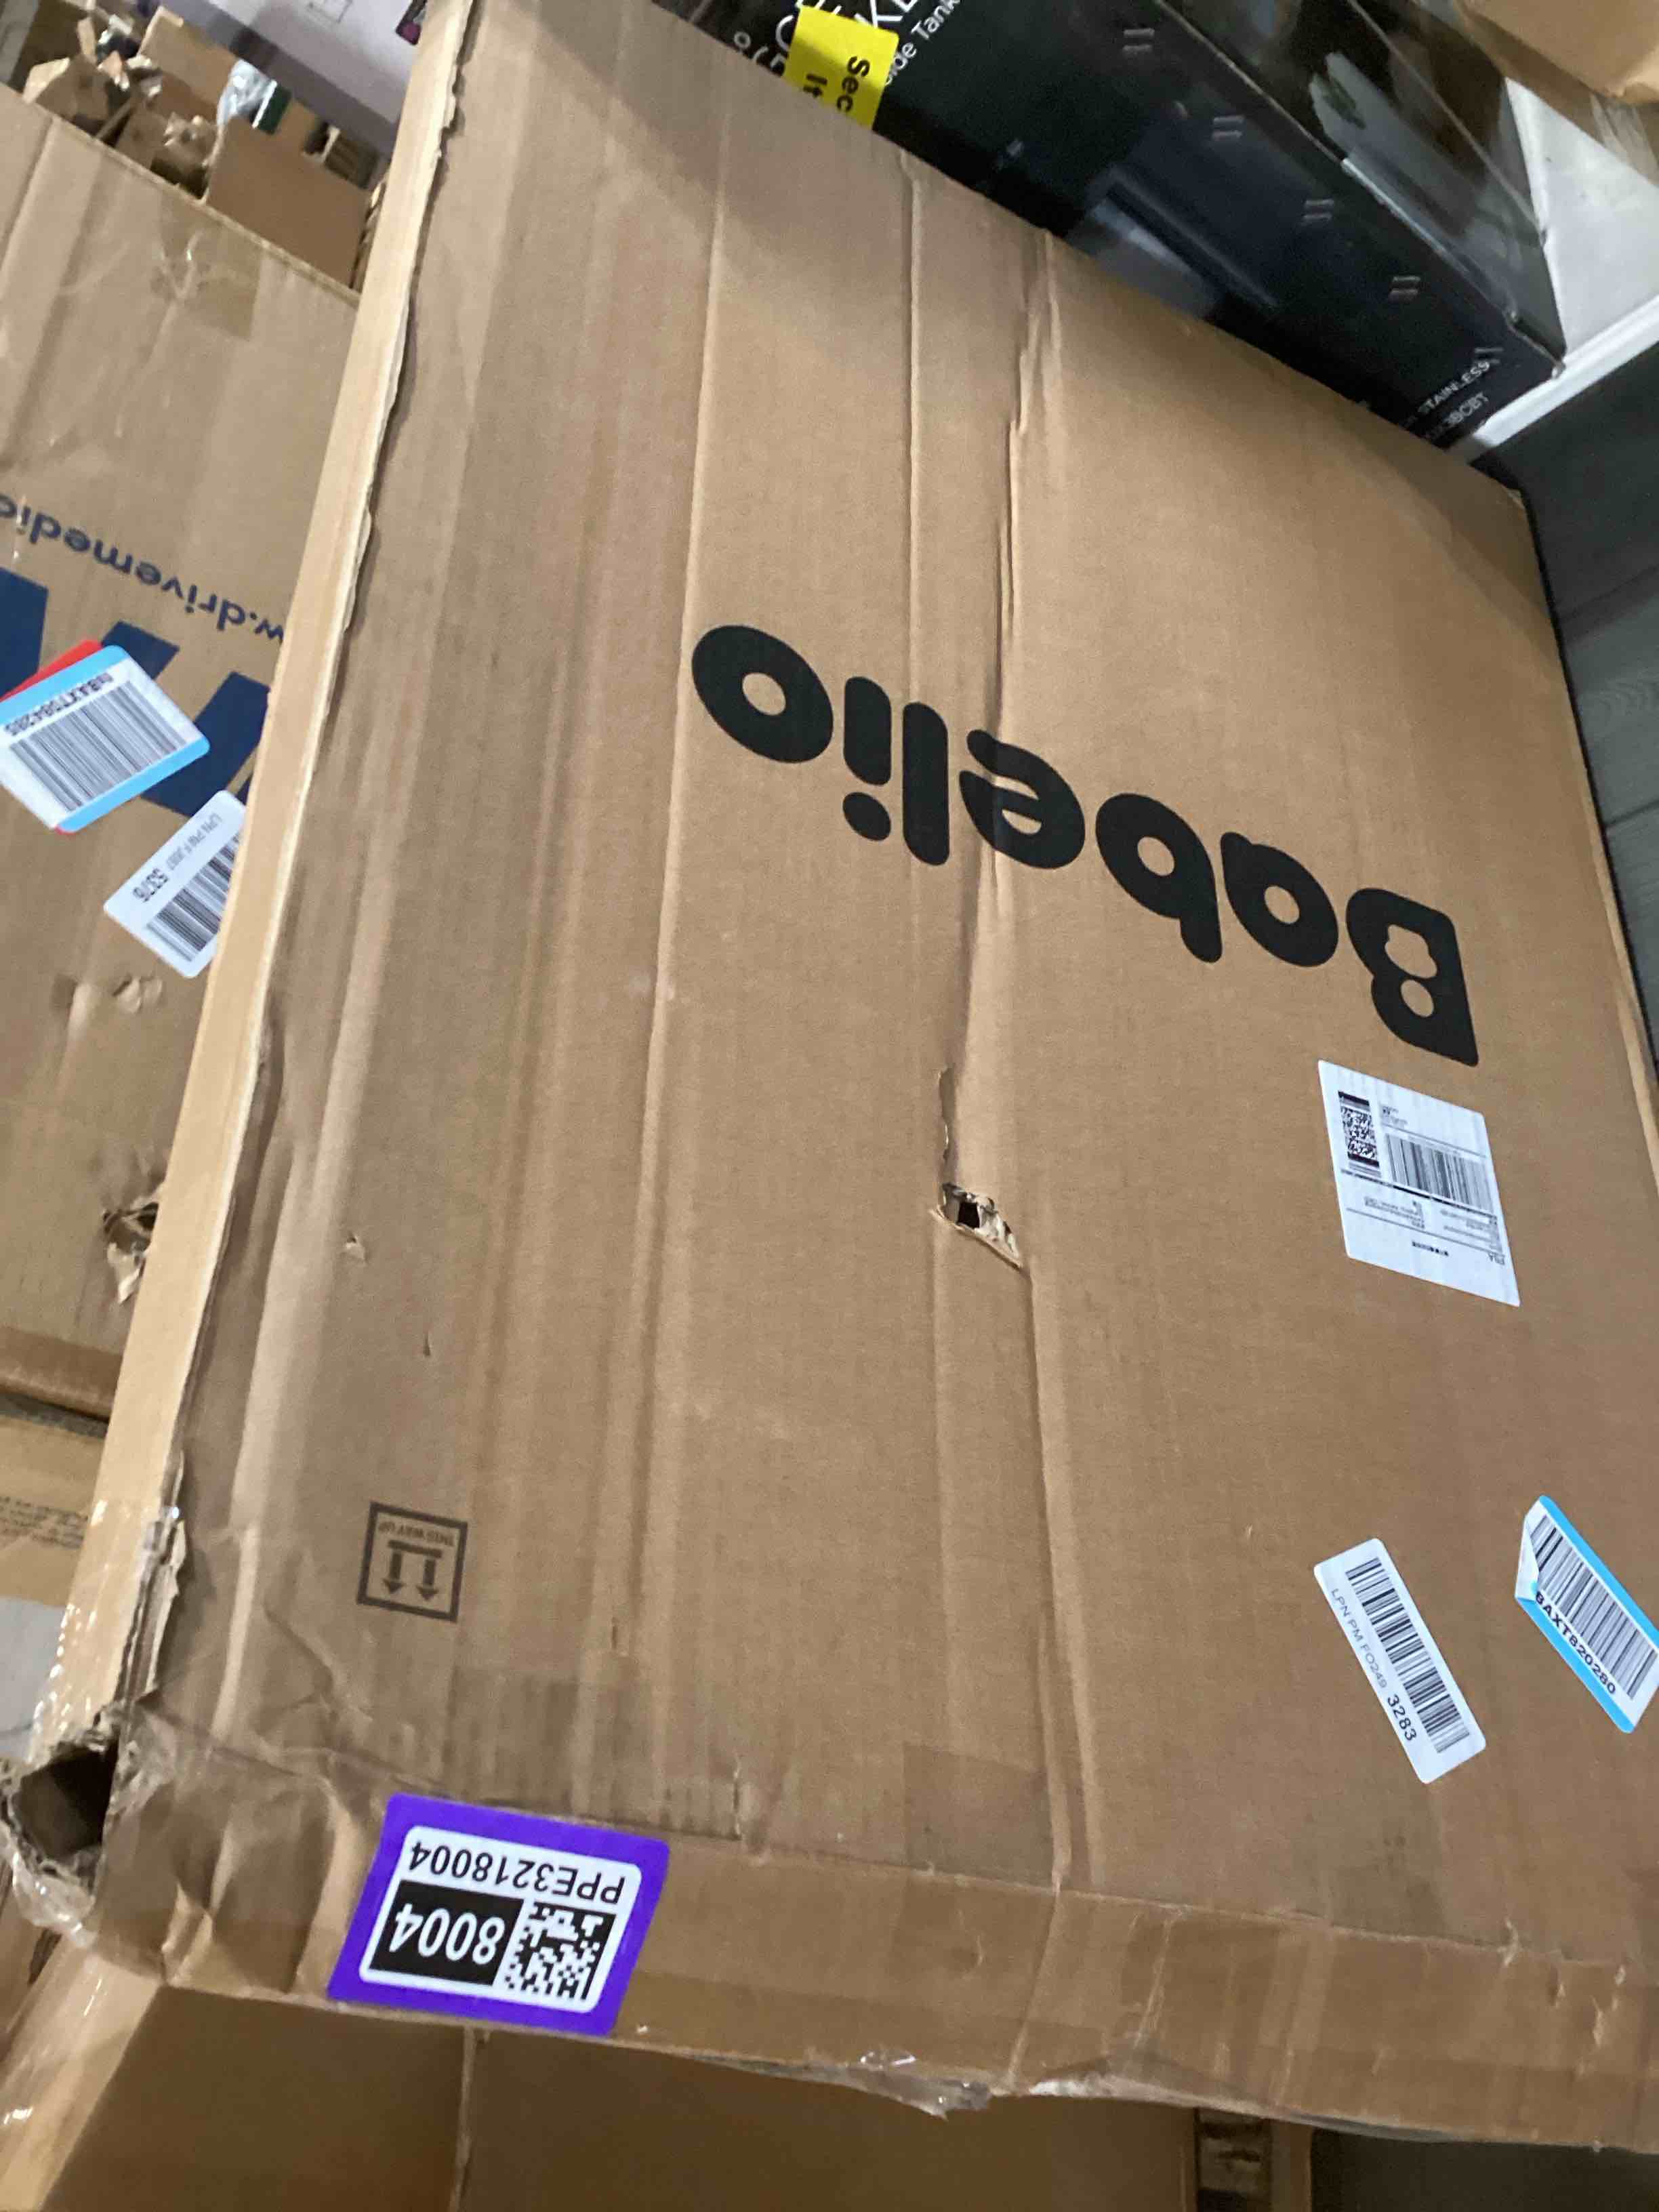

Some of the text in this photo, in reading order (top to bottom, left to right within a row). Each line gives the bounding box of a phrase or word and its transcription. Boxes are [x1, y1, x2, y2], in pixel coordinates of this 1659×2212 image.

[691, 624, 1478, 1066] Babelio
[1331, 1588, 1352, 1618] LPN
[1348, 1620, 1364, 1642] PM
[1387, 1694, 1418, 1742] 3283
[408, 1841, 626, 1905] PPE3218004
[388, 1902, 506, 1965] 8004
